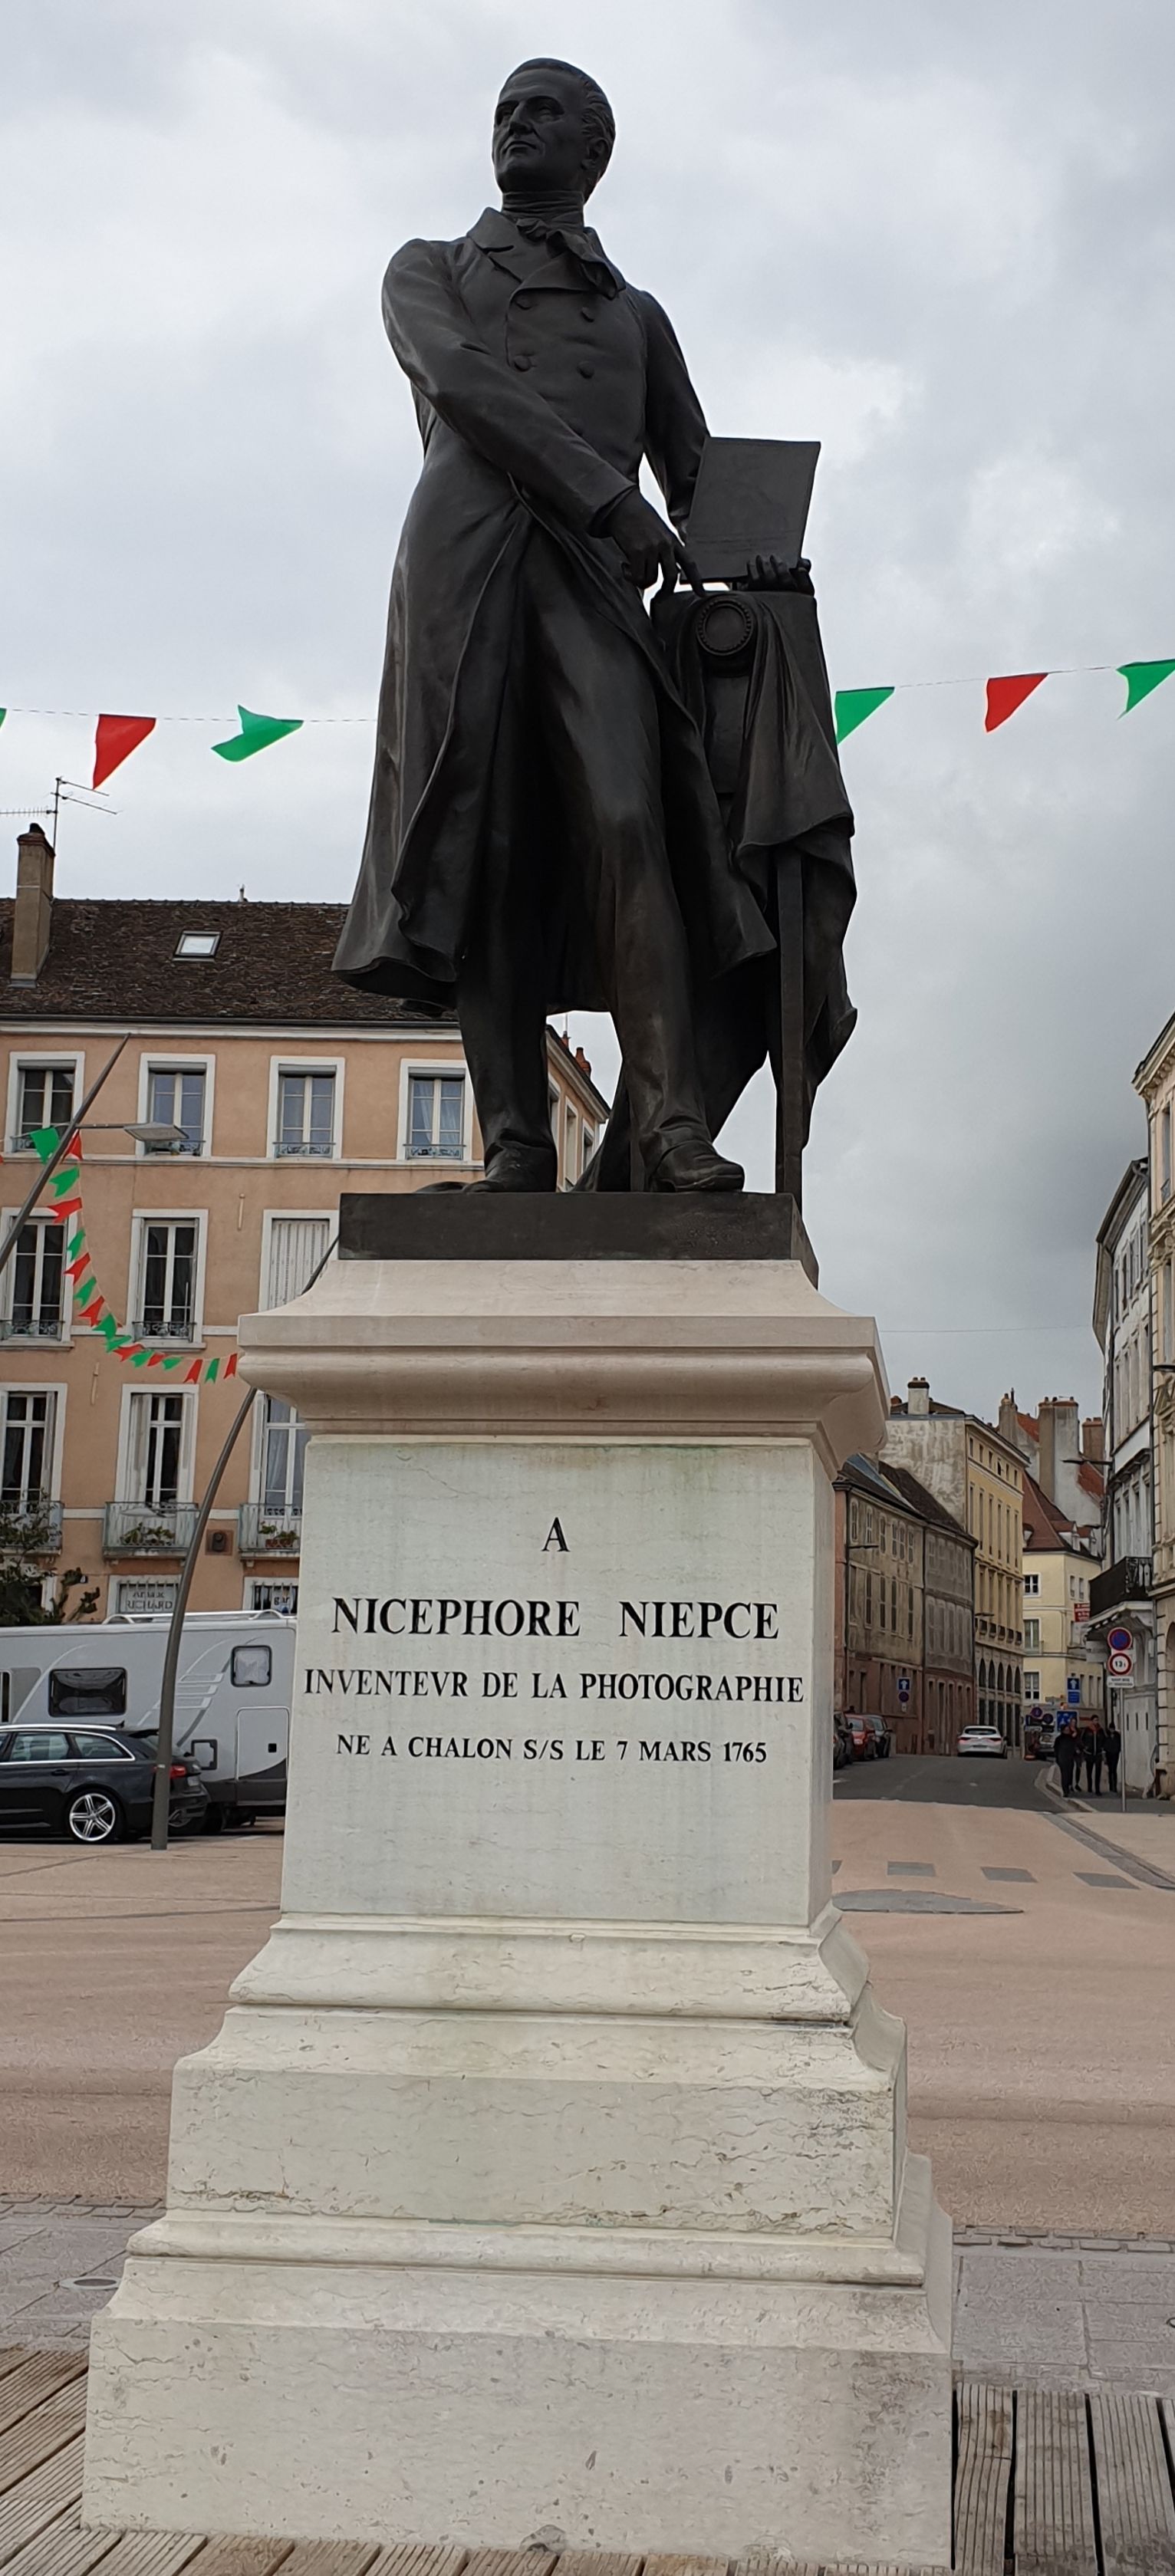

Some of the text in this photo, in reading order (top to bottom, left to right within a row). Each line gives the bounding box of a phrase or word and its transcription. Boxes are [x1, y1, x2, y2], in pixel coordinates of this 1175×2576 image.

[541, 1517, 570, 1552] A
[331, 1597, 778, 1640] NICEPHORE NIEPCE
[304, 1669, 804, 1703] INVENTEVR DE LA PHOTOGRAPHIE
[337, 1734, 767, 1763] NE A CHALON S/S LE 7 MARS 1765
